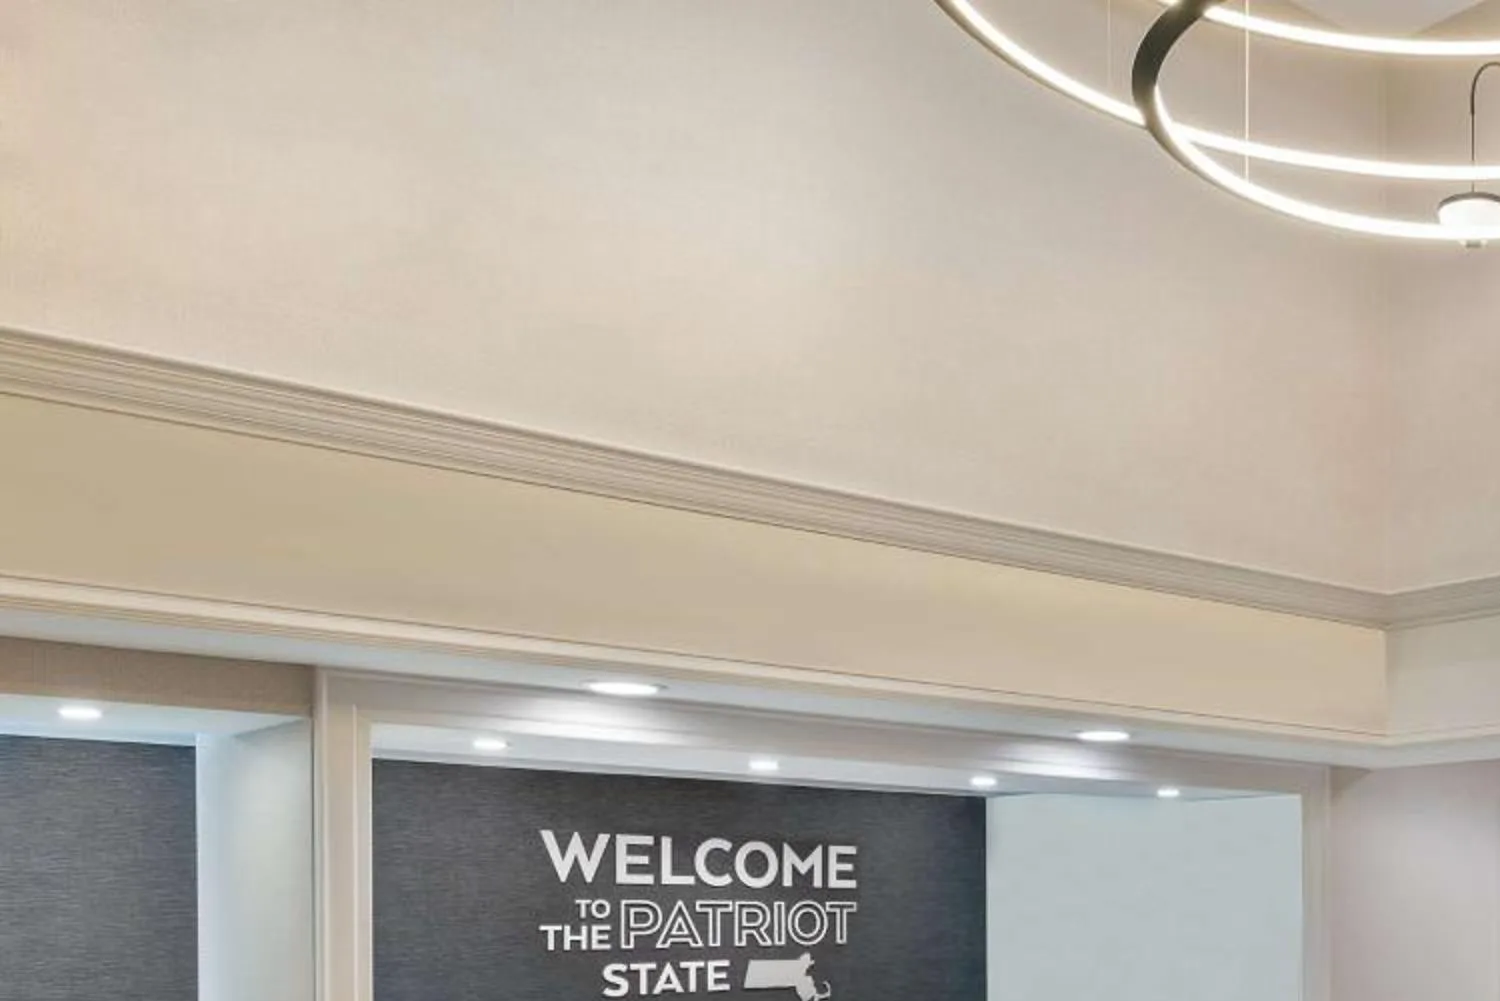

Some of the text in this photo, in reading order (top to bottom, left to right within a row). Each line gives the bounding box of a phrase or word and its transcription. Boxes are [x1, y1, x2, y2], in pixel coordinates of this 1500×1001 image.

[540, 829, 857, 888] WELCOME
[538, 899, 857, 950] THE PATRIOT
[575, 899, 611, 919] TO
[602, 959, 731, 997] STATE
